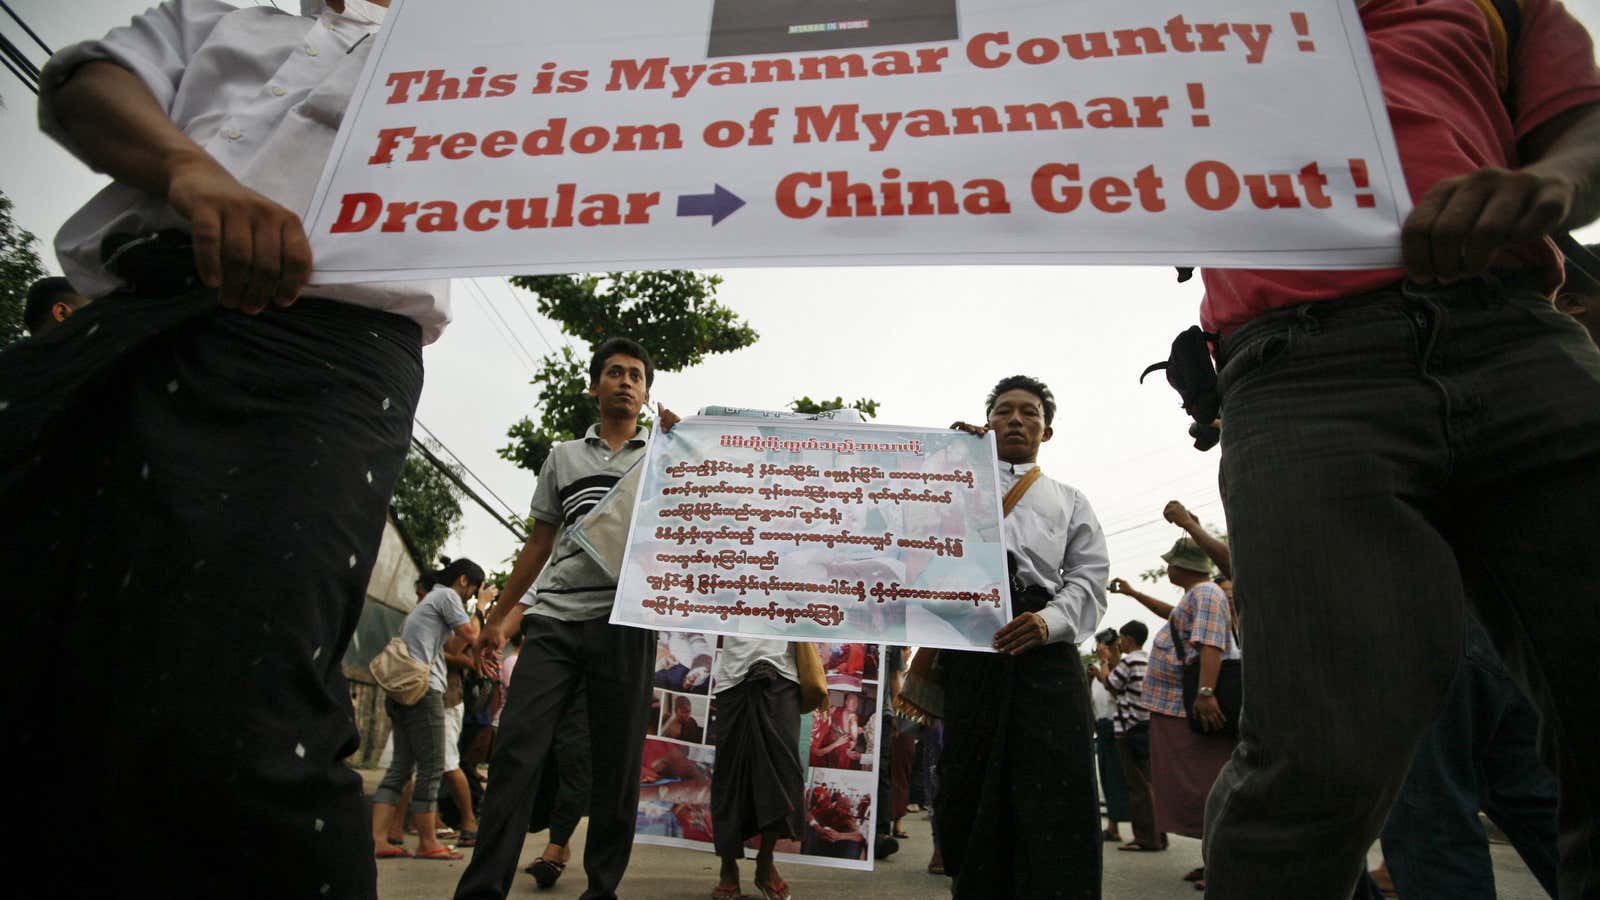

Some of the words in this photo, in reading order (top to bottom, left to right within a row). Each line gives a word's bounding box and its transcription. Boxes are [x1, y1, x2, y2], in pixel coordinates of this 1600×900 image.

[387, 67, 517, 104] This
[532, 63, 588, 94] is
[606, 48, 948, 98] Myanmar
[966, 17, 1272, 69] Country
[1291, 13, 1314, 51] !
[368, 118, 683, 165] Freedom
[703, 108, 779, 148] of
[794, 96, 1168, 152] Myanmar
[1187, 83, 1209, 127] !
[330, 183, 660, 234] Dracular
[775, 168, 1011, 219] China
[1031, 163, 1166, 214] Get
[1185, 160, 1332, 211] Out
[1349, 160, 1375, 208] !
